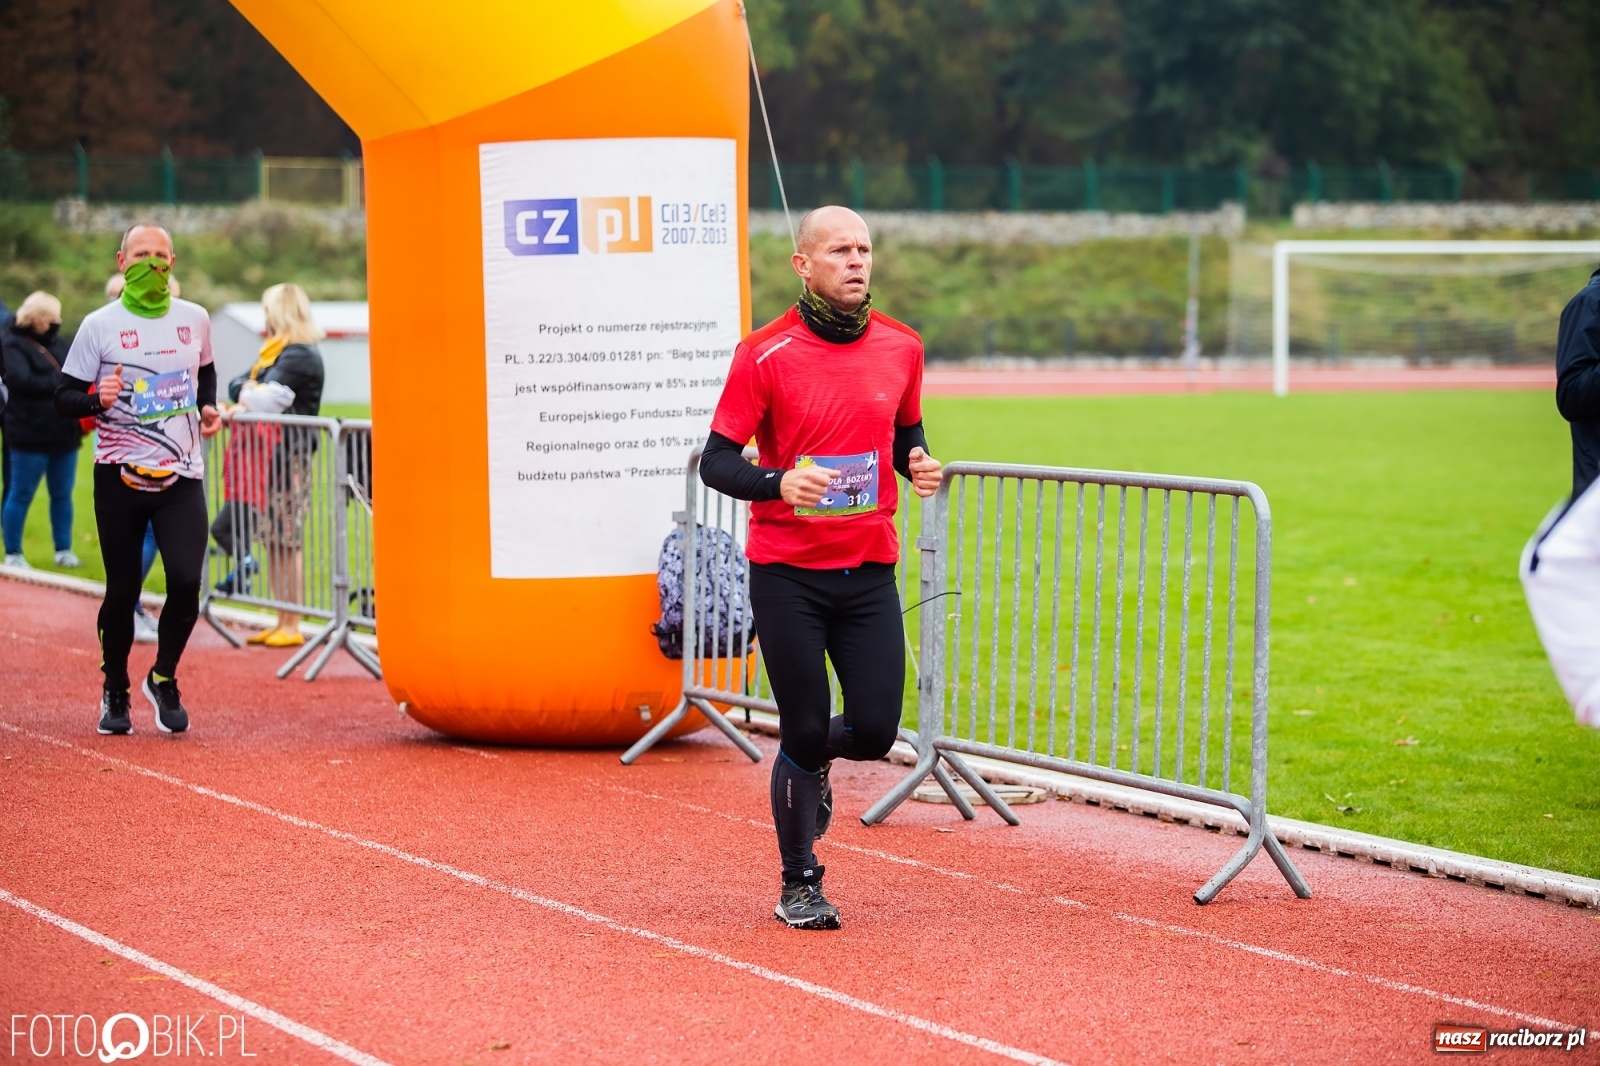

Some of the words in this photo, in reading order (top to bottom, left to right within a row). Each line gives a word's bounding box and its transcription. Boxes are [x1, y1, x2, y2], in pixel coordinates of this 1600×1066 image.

[515, 209, 570, 245] cz
[597, 196, 640, 254] pl
[539, 323, 582, 336] Projekt
[586, 325, 594, 333] o
[597, 323, 647, 333] numerze
[650, 320, 718, 332] rejestracyjnym
[505, 353, 524, 364] PL.
[528, 351, 643, 364] 3.22/3.304/09.01281
[646, 352, 664, 362] pn:
[696, 349, 710, 358] bez
[514, 383, 537, 396] jest
[541, 379, 652, 394] współfinansowany
[655, 381, 664, 389] w
[666, 377, 686, 389] 85%
[689, 380, 699, 388] ze
[539, 409, 627, 424] Europejskiego
[630, 408, 682, 420] Funduszu
[526, 440, 610, 454] Regionalnego
[614, 439, 640, 449] oraz
[642, 438, 657, 449] do
[660, 436, 680, 447] 10%
[683, 438, 694, 446] ze
[518, 469, 567, 481] budżetu
[570, 468, 621, 482] państwa
[847, 492, 870, 506] 319
